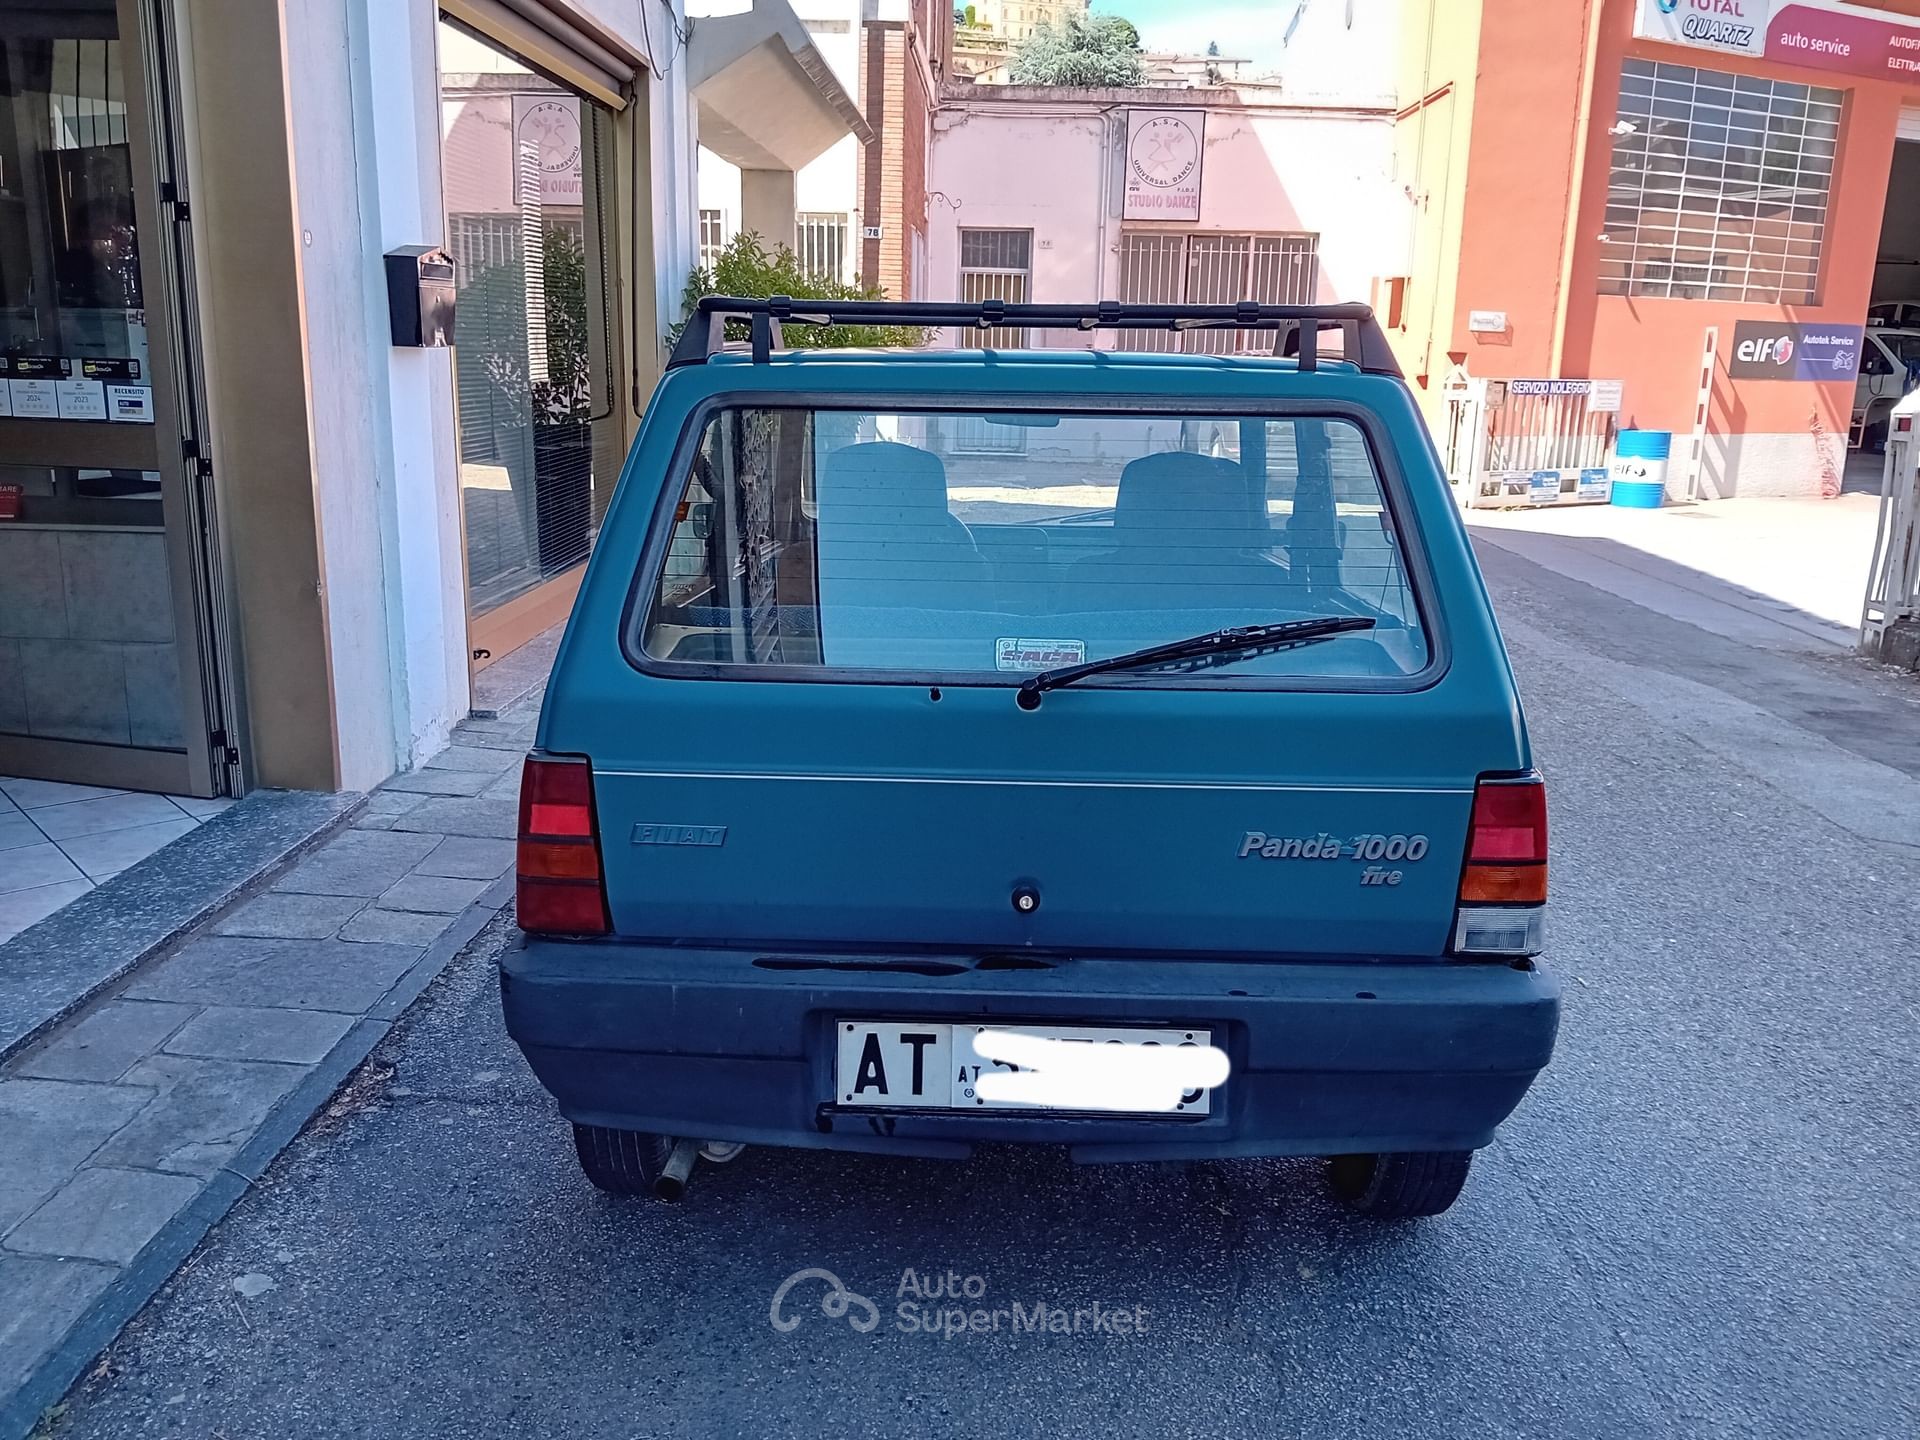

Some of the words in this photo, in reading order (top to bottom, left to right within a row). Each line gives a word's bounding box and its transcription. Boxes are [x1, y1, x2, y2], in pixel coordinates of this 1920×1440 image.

[1682, 14, 1754, 47] QUARTZ
[1780, 32, 1809, 49] auto
[1810, 38, 1851, 56] service
[1133, 159, 1169, 185] UNIVERSAL
[1172, 160, 1194, 183] DANCE
[1128, 194, 1163, 208] STUDIO
[1166, 195, 1197, 208] DANZE
[1737, 338, 1775, 362] elf
[1803, 334, 1829, 345] Autotek
[1830, 335, 1854, 346] Service
[1512, 381, 1549, 394] SERVIZIO
[1550, 381, 1591, 394] NOLEGGIO
[637, 825, 722, 844] FIAT
[1237, 831, 1343, 860] Panda
[1351, 833, 1429, 861] 1000
[1360, 865, 1403, 885] fire
[853, 1032, 937, 1096] AT
